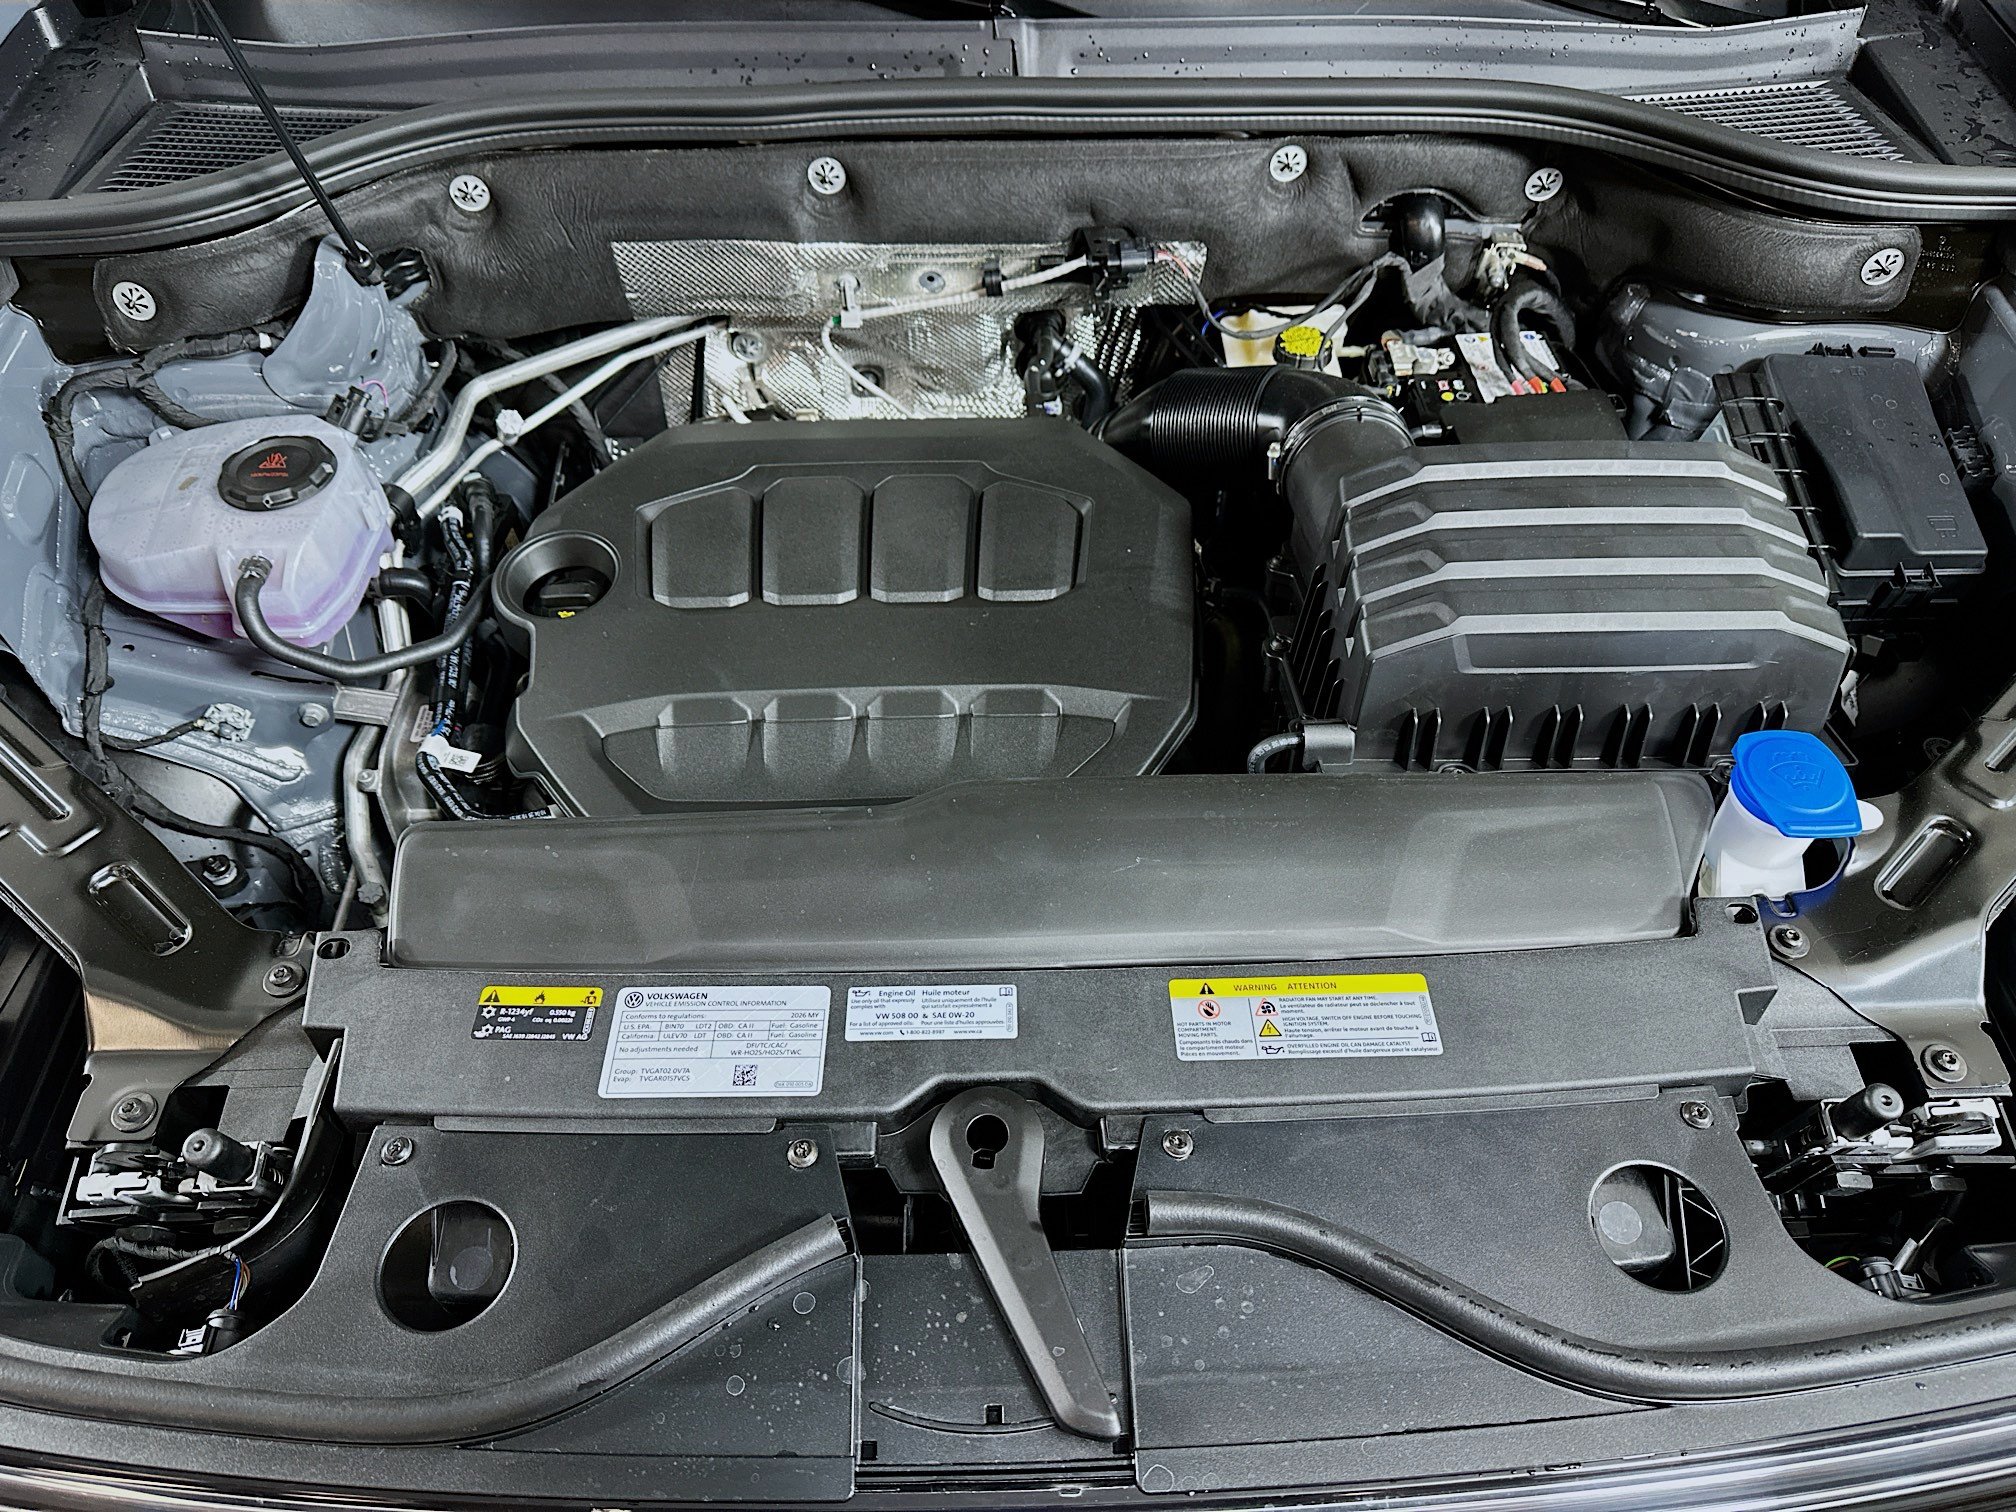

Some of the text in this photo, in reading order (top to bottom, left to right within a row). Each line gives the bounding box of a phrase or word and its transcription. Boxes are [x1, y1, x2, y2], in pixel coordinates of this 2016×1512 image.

[1233, 982, 1337, 992] WARNING ATTENTION
[647, 992, 708, 1000] VOLKSWAGEN
[879, 990, 904, 998] Engine
[499, 1007, 535, 1017] R-1234yf
[567, 1009, 577, 1017] kg
[494, 1026, 512, 1034] PAG
[630, 1046, 672, 1054] adjustments
